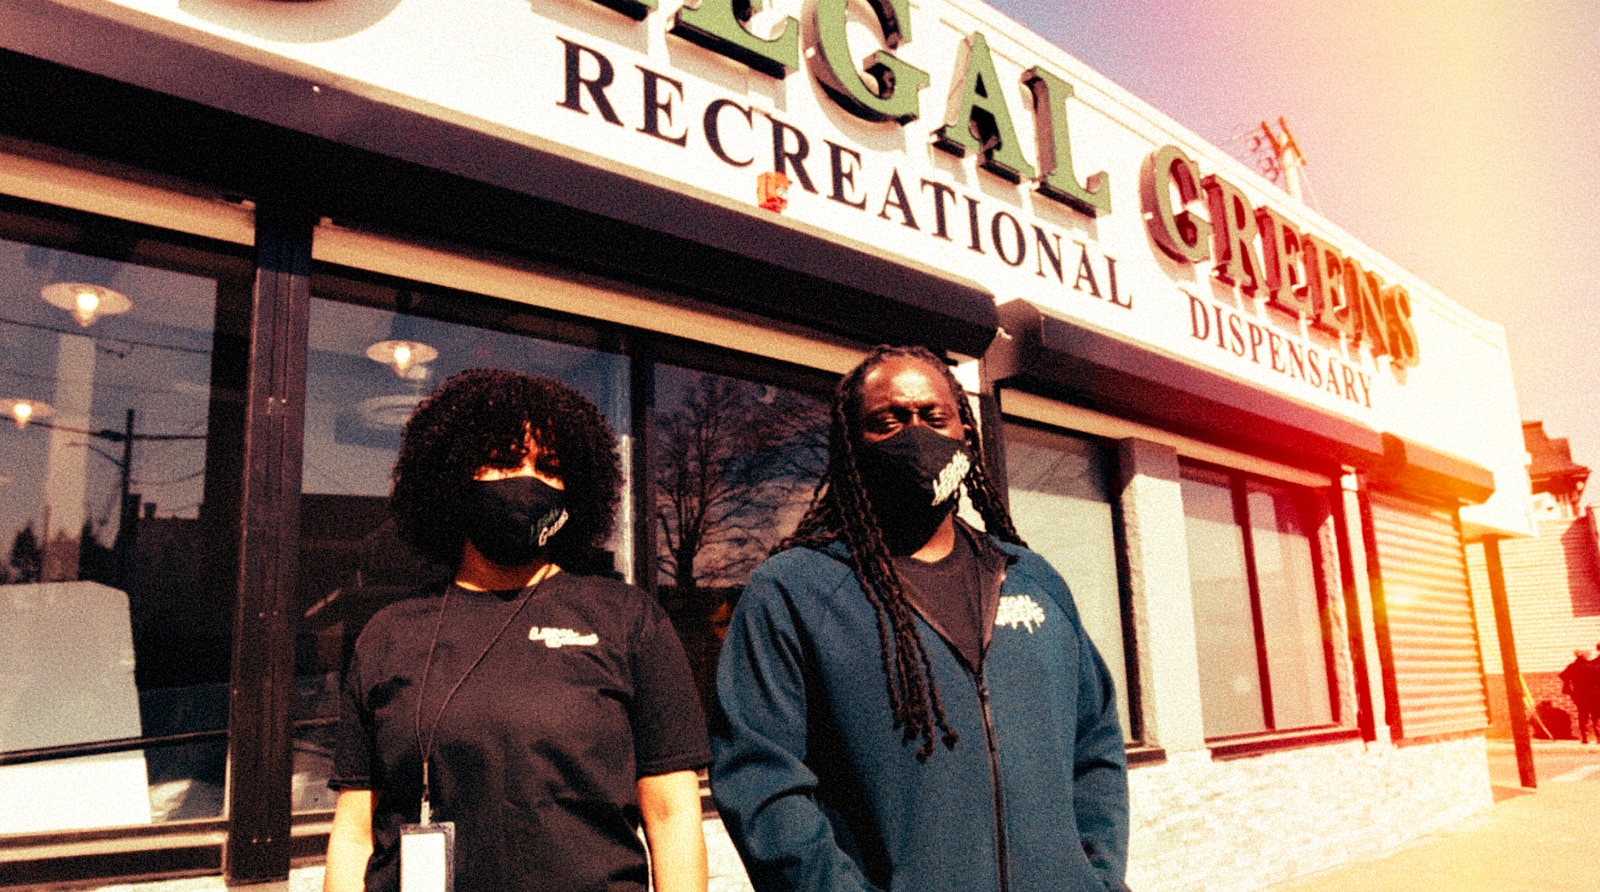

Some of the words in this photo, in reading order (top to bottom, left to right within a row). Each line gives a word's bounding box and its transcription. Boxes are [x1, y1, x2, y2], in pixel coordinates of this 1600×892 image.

[554, 35, 1133, 310] RECREATIONAL
[1184, 288, 1373, 410] DISPENSARY
[1140, 143, 1420, 370] GREENS
